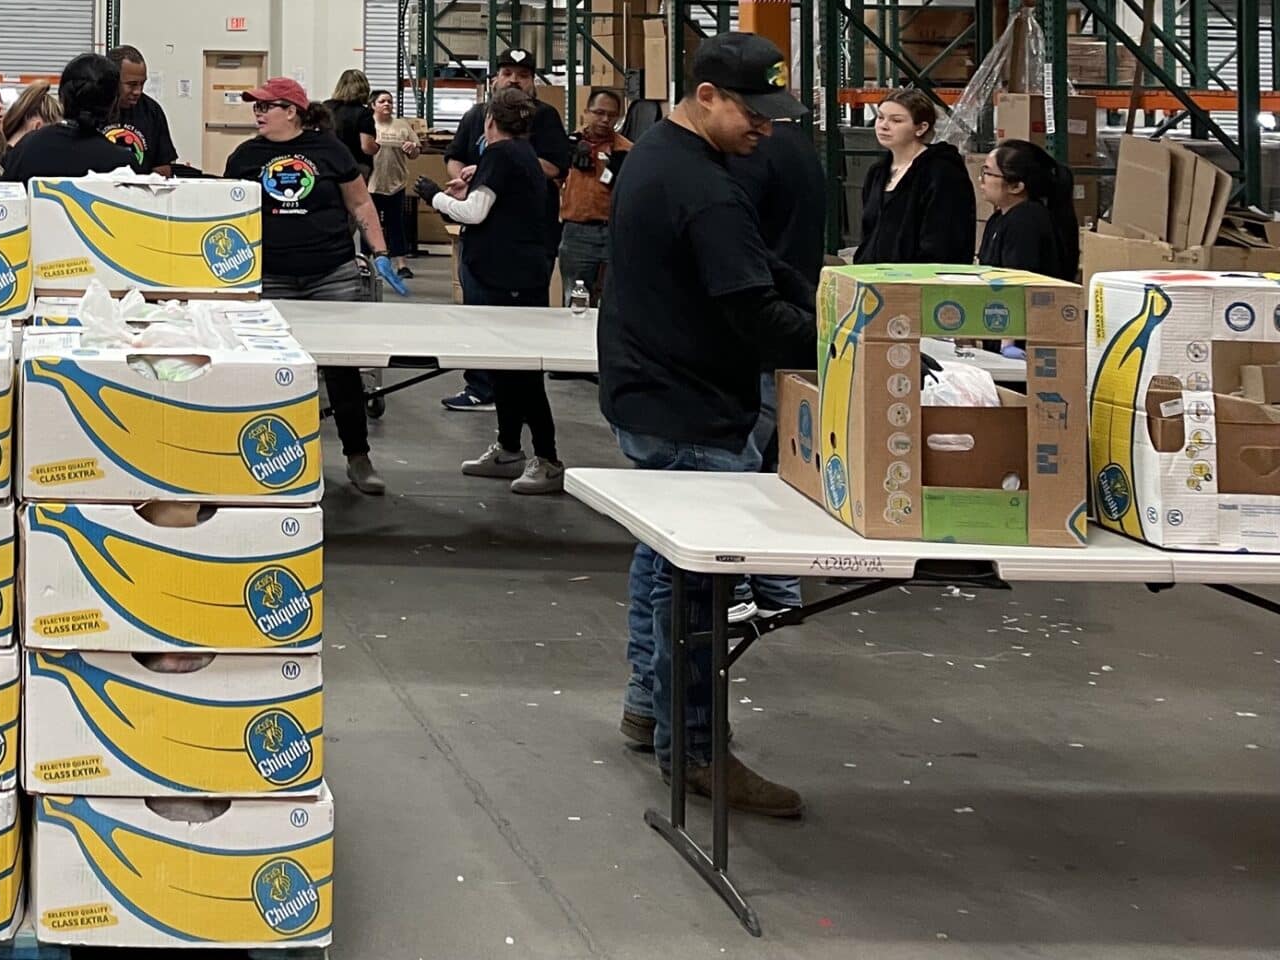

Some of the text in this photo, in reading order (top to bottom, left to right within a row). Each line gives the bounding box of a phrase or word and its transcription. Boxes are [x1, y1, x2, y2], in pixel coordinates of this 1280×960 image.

[230, 17, 245, 29] EXIT
[211, 246, 252, 277] Chiquita
[43, 266, 89, 278] CLASS EXTRA
[35, 460, 95, 474] SELECTED QUALITY
[252, 442, 304, 482] Chiquita
[39, 468, 96, 483] CLASS EXTRA
[1099, 471, 1119, 519] Chiquita
[39, 612, 100, 626] SELECTED QUALITY
[257, 593, 310, 633] Chiquita
[42, 621, 101, 634] CLASS EXTRA
[258, 736, 310, 777] Chiquita
[39, 758, 100, 771] SELECTED QUALITY
[43, 766, 101, 780] CLASS EXTRA
[48, 906, 108, 919] SELECTED QUALITY
[264, 885, 317, 927] Chiquita
[51, 915, 109, 929] CLASS EXTRA
